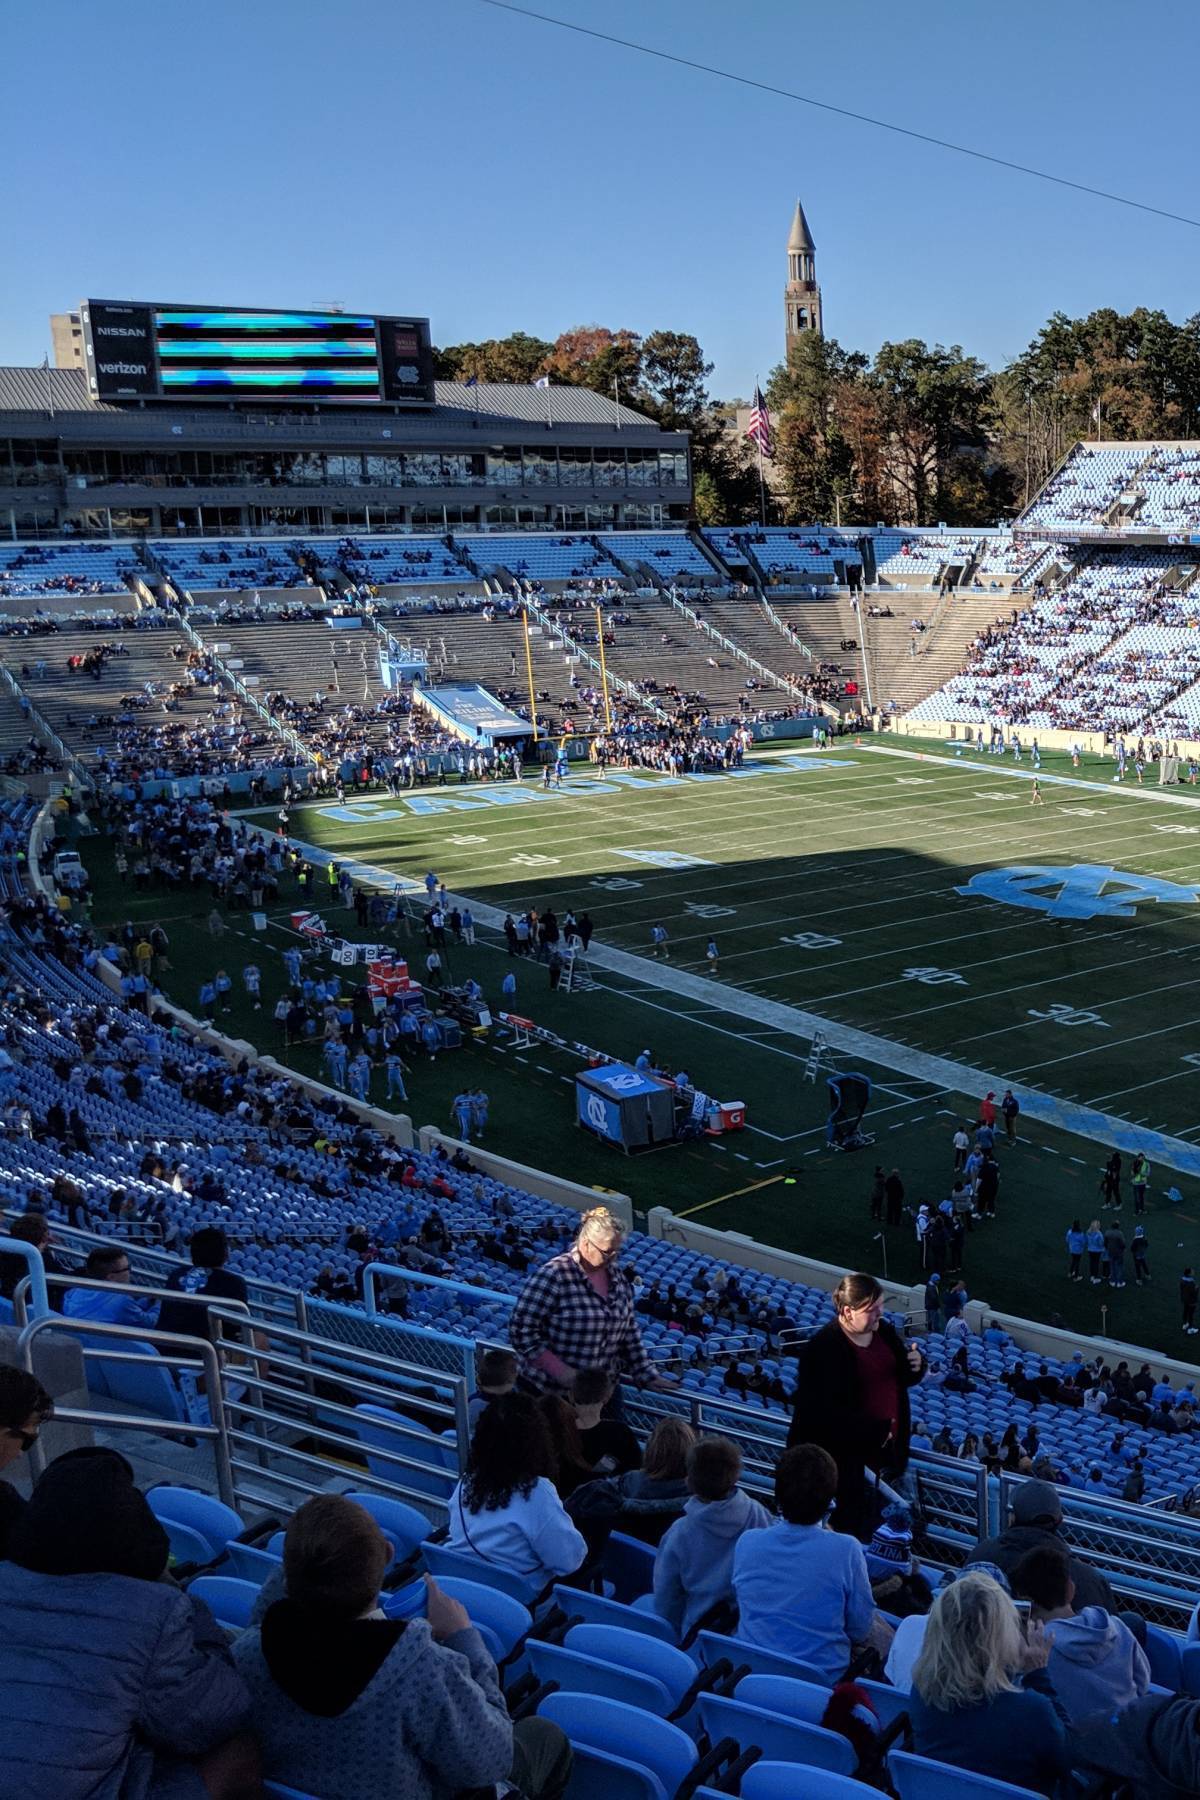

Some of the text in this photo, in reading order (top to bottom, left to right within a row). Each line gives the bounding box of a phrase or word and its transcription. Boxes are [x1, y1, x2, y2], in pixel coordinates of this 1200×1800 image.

[97, 328, 148, 338] NISSAN
[98, 361, 148, 376] verizon
[779, 932, 843, 949] 50
[901, 967, 963, 984] 40
[1027, 1003, 1102, 1026] 30
[730, 1112, 742, 1123] G
